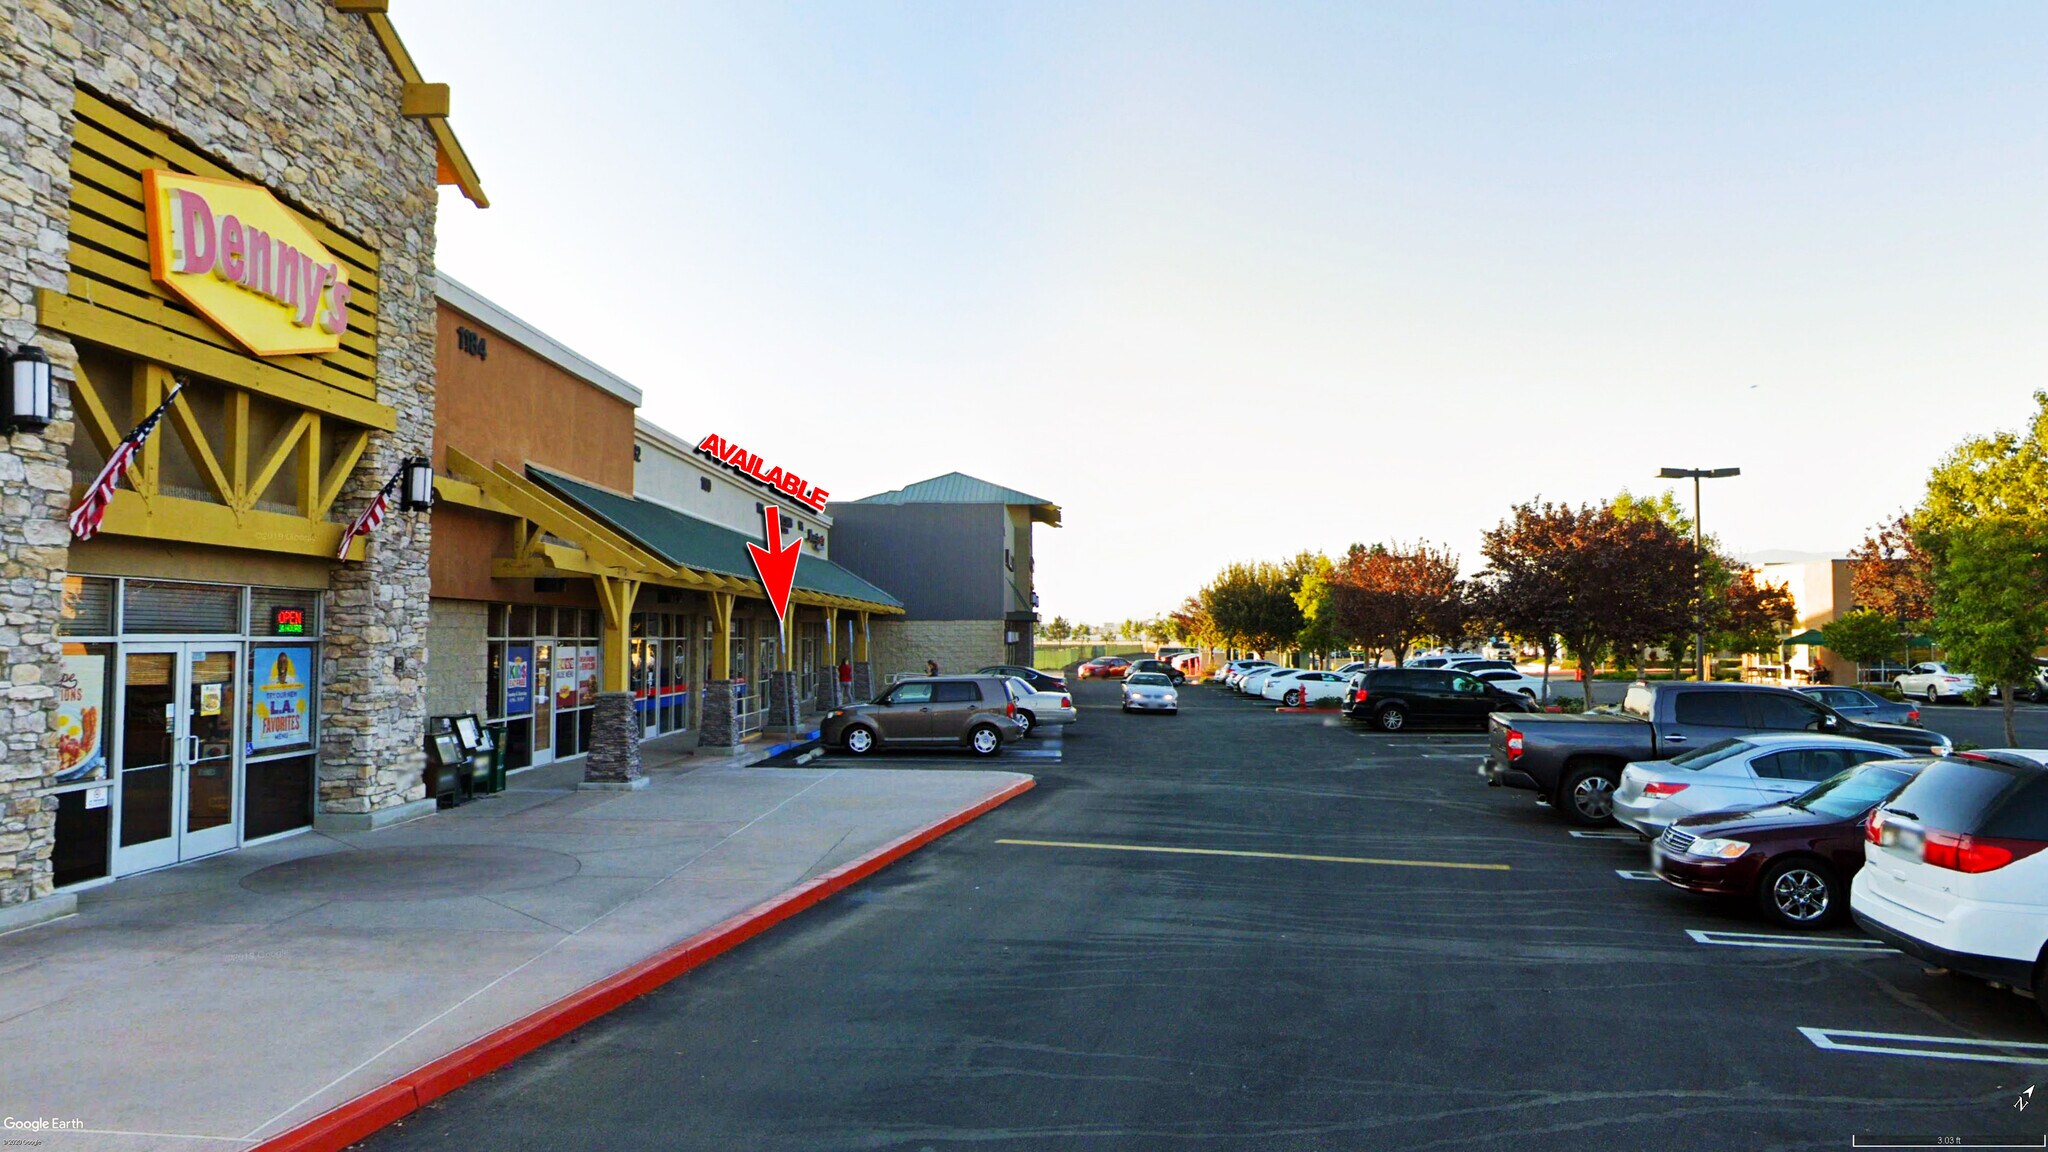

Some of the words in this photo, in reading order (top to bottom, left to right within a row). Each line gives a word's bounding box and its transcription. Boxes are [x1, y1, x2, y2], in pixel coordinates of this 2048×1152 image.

[168, 188, 351, 335] Denny's
[277, 609, 303, 625] OPEN
[270, 699, 294, 715] L.A.
[262, 714, 300, 734] FAVORITES
